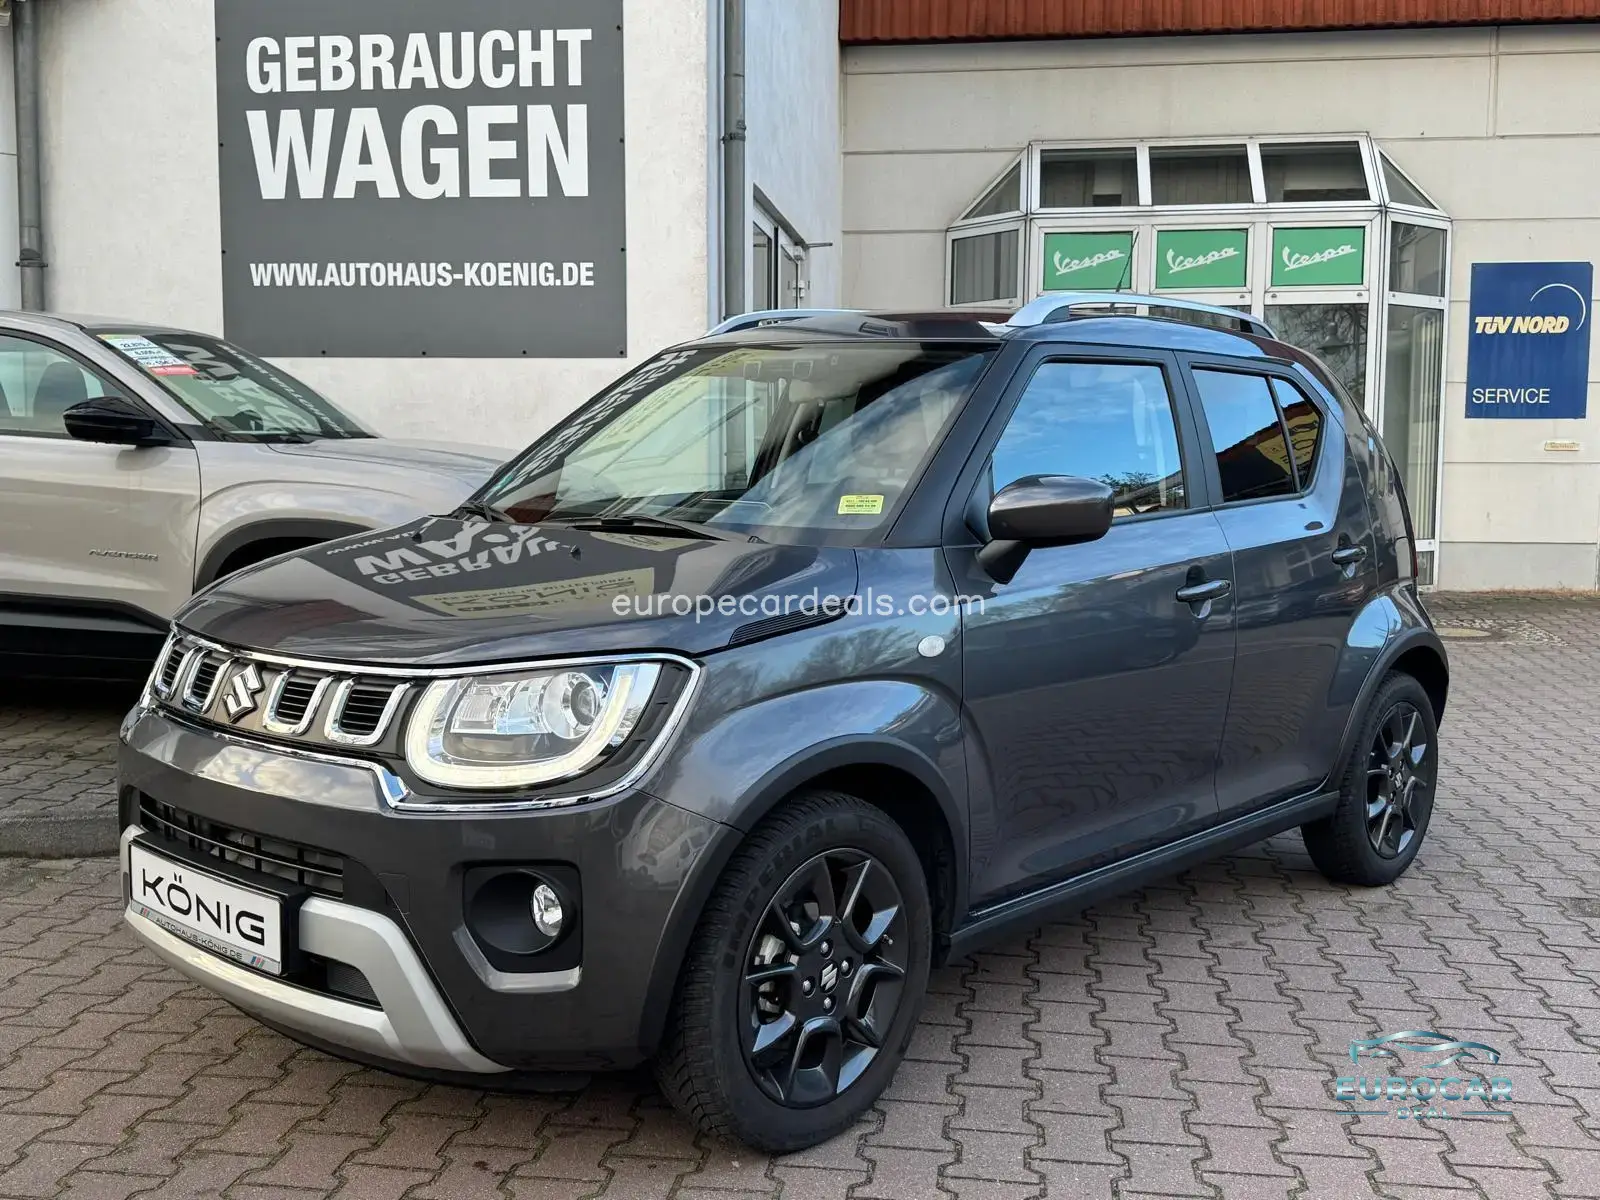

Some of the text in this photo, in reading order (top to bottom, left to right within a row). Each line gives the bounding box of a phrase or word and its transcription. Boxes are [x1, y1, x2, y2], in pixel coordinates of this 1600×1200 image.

[246, 28, 592, 94] GEBRAUCHT
[245, 104, 589, 200] WAGEN
[1053, 249, 1125, 276] Vespa
[1166, 247, 1240, 274] Vespa
[1282, 245, 1357, 272] Vespa
[250, 262, 594, 287] WWW.AUTOHAUS-KOENIG.DE
[1511, 316, 1570, 334] NORD
[1472, 388, 1550, 404] SERVICE
[141, 868, 265, 946] KÖNIG
